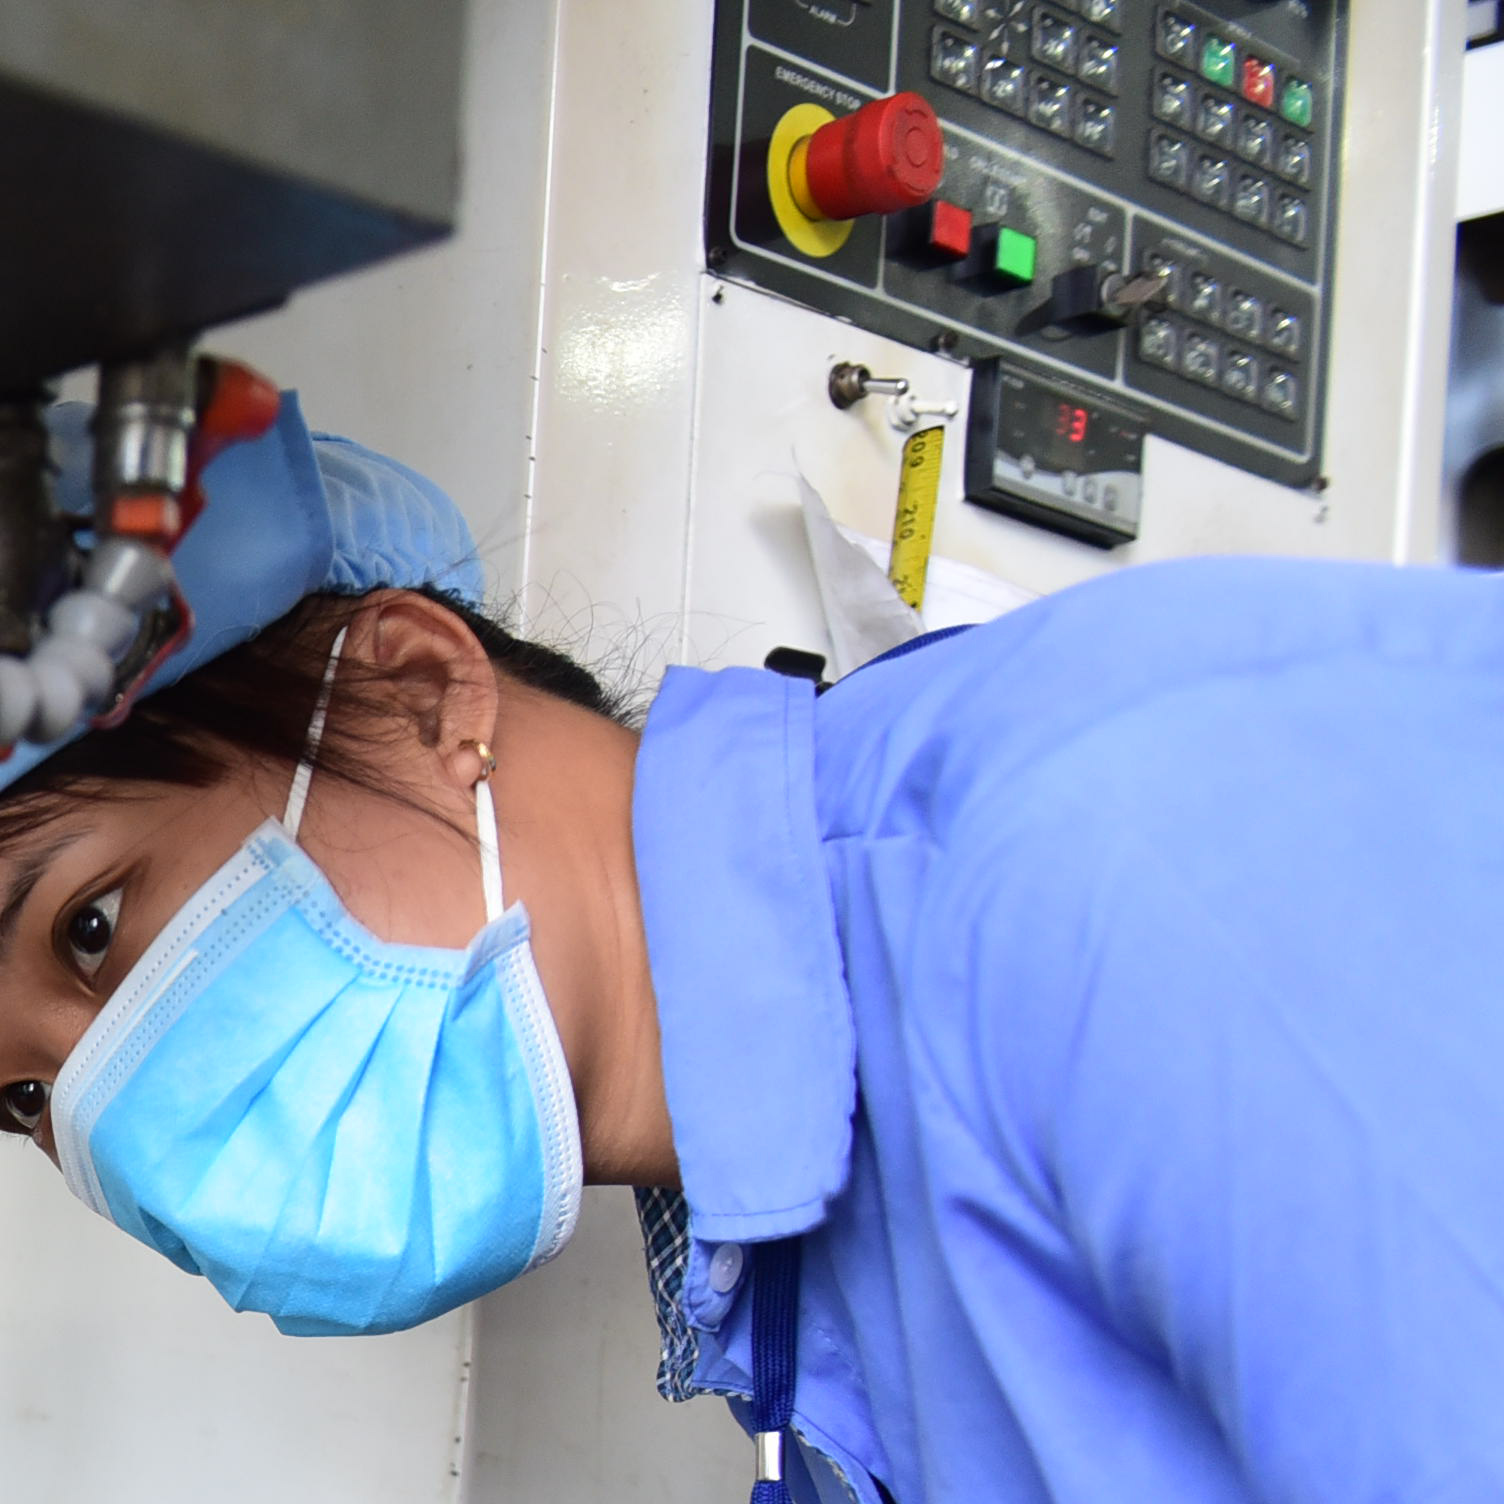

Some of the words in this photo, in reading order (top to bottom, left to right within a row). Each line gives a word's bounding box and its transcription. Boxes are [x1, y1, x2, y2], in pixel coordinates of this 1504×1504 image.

[774, 65, 835, 100] EMERGENCY
[835, 89, 862, 111] STOP
[898, 502, 918, 540] 210
